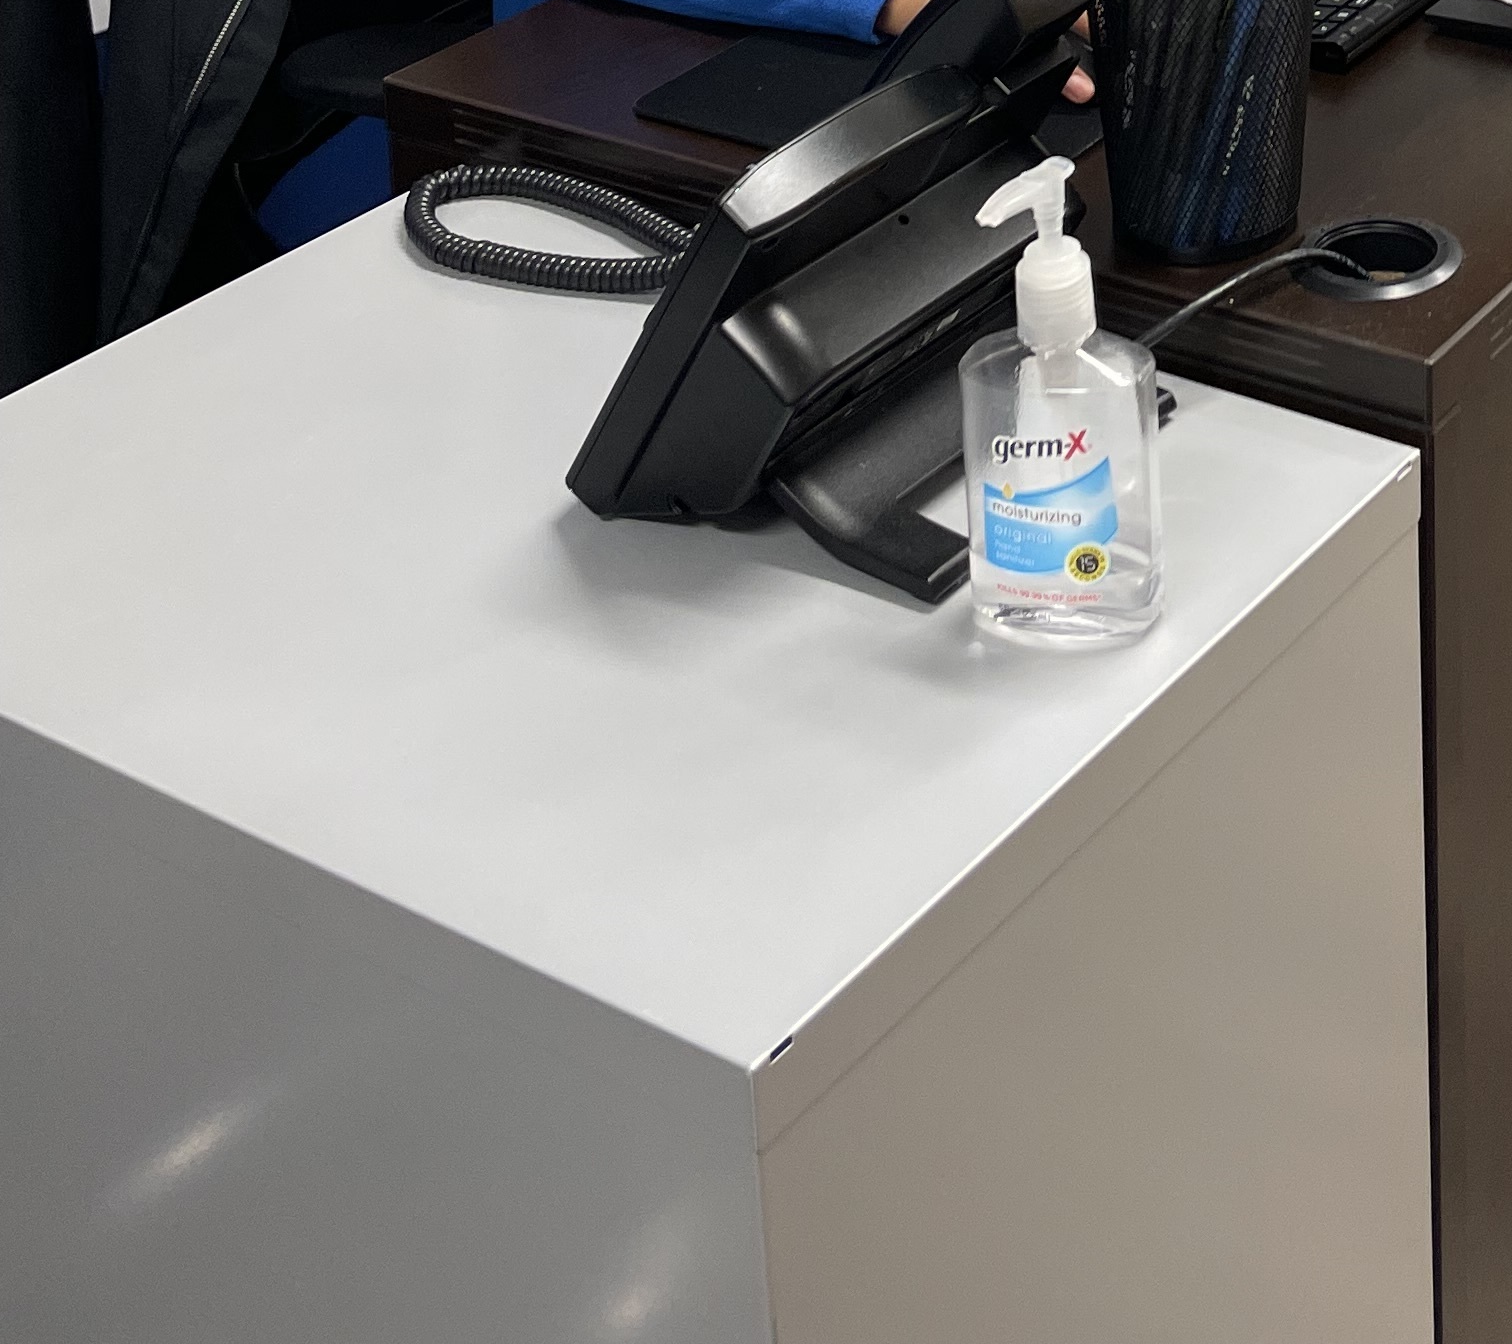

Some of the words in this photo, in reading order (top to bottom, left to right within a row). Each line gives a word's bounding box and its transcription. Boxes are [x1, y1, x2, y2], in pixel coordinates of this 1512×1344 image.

[992, 500, 1082, 526] moisturizing
[994, 524, 1052, 545] original
[994, 538, 1022, 554] hand
[1081, 555, 1096, 572] 15
